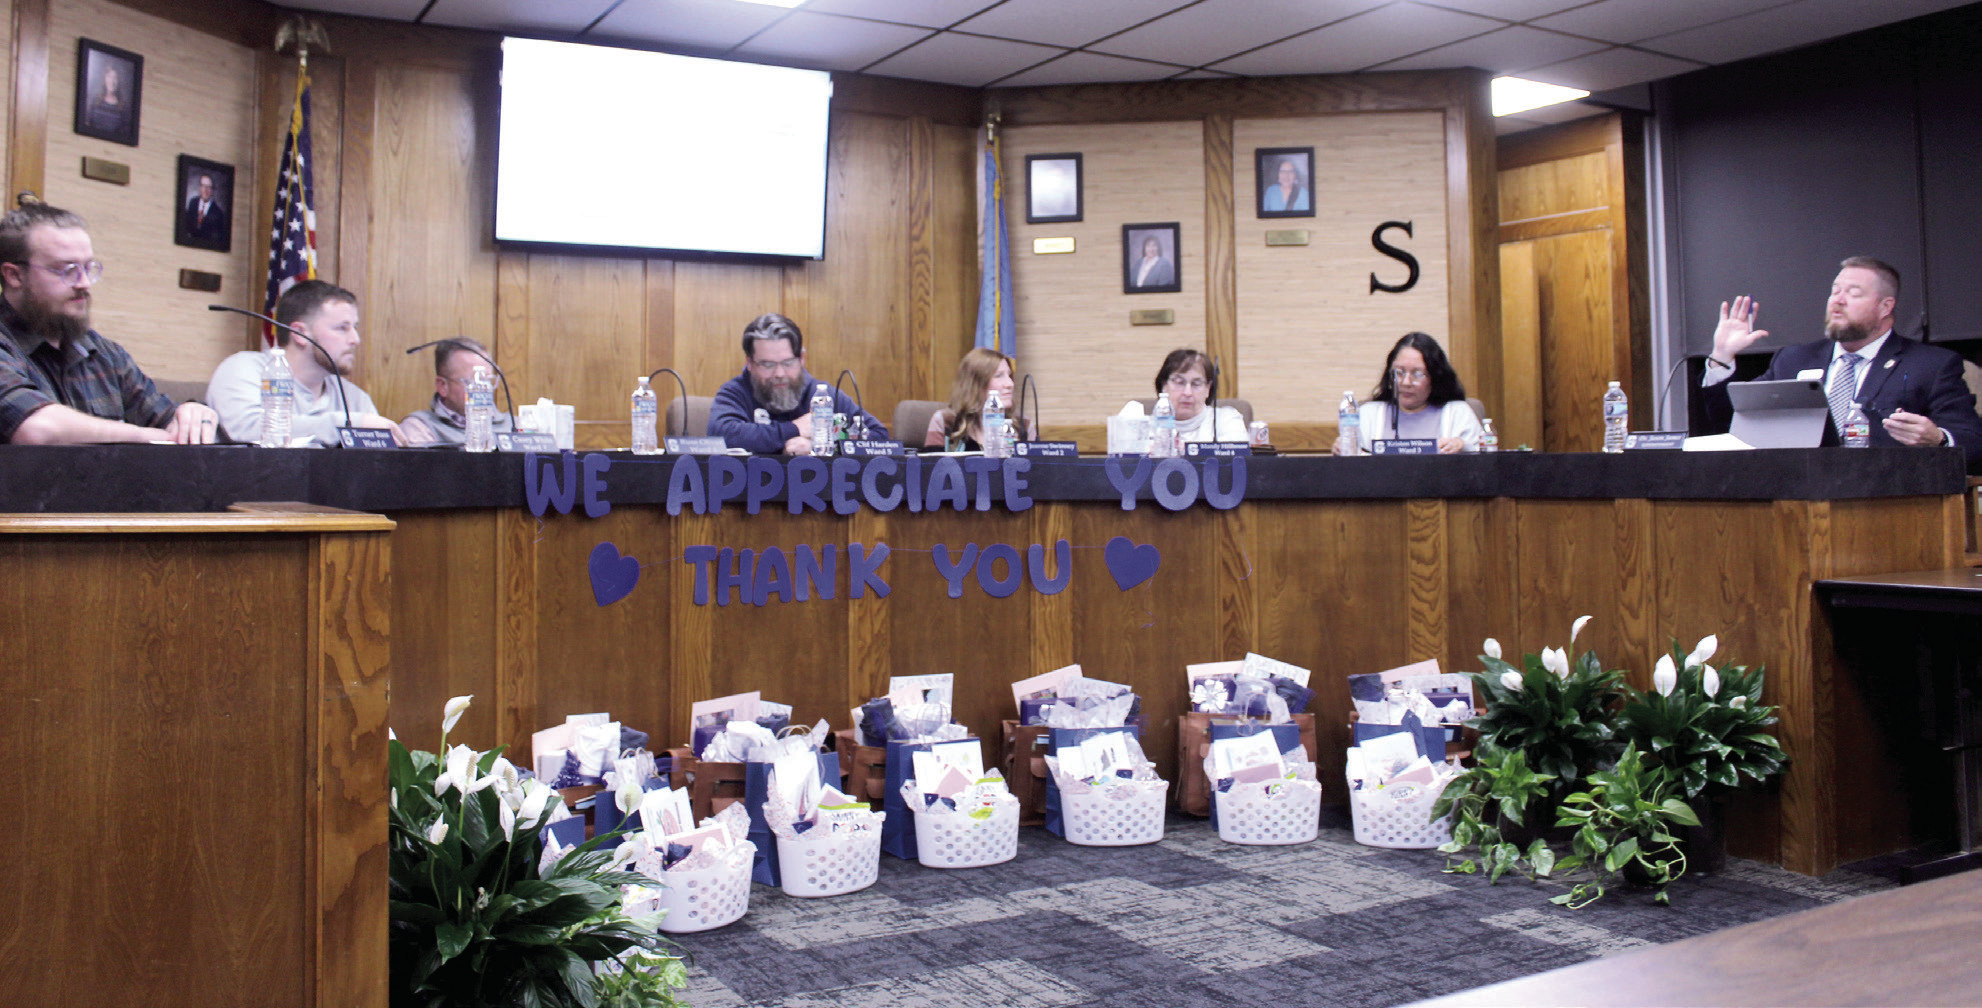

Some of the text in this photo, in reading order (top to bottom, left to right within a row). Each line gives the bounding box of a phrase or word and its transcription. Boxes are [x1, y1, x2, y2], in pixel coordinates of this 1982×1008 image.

[1370, 221, 1420, 293] S
[362, 439, 381, 448] Ward
[524, 452, 1247, 518] WE APPRECIATE YOU
[684, 539, 1072, 607] THANK YOU
